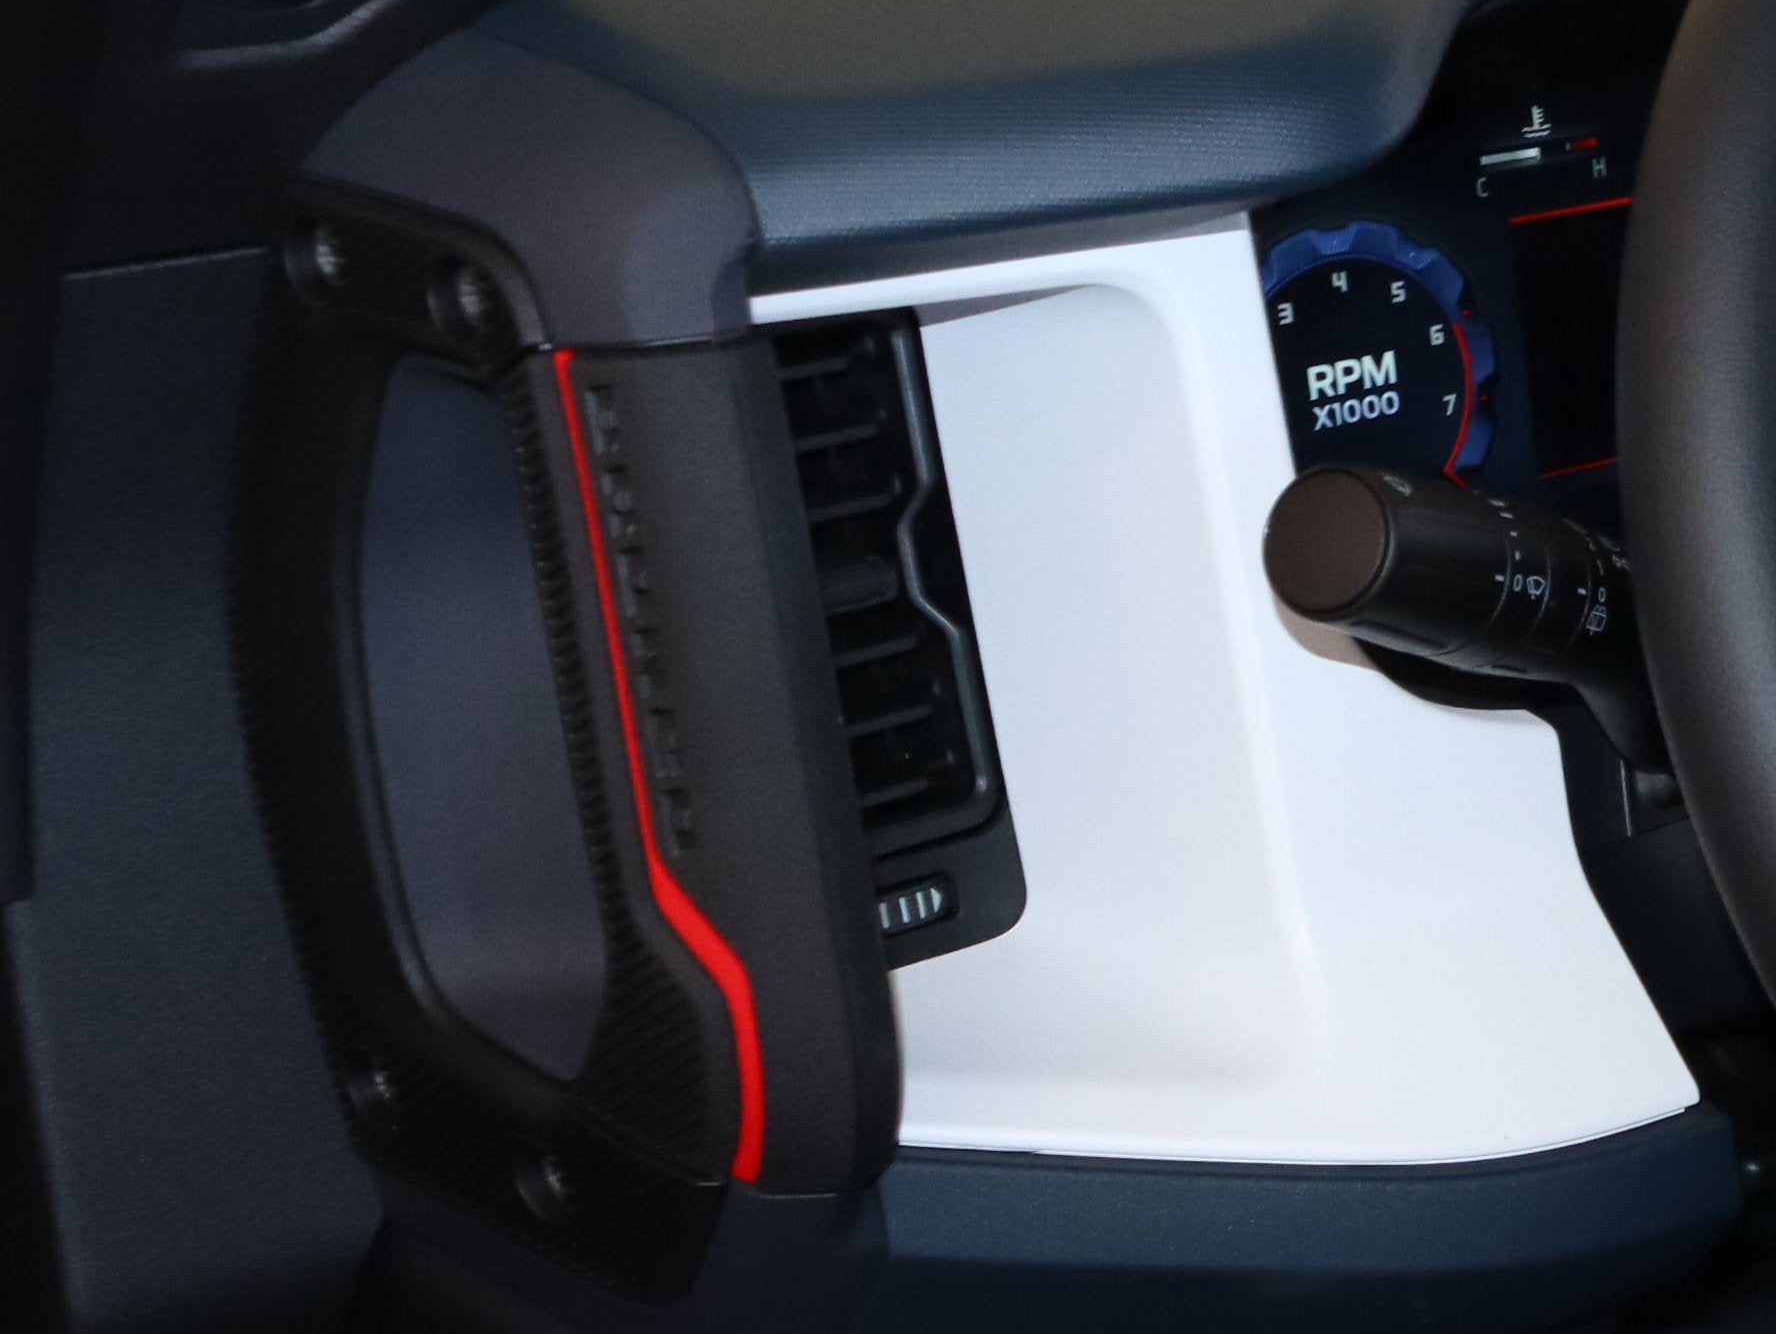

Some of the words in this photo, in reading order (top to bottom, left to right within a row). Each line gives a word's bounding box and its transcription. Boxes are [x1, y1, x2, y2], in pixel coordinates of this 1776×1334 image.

[1592, 157, 1607, 179] H
[1475, 176, 1489, 198] C
[1331, 271, 1349, 293] 4
[1390, 280, 1407, 304] 5
[1276, 302, 1294, 325] 3
[1428, 323, 1445, 346] 6
[1305, 349, 1399, 402] RPM
[1442, 393, 1457, 416] 7
